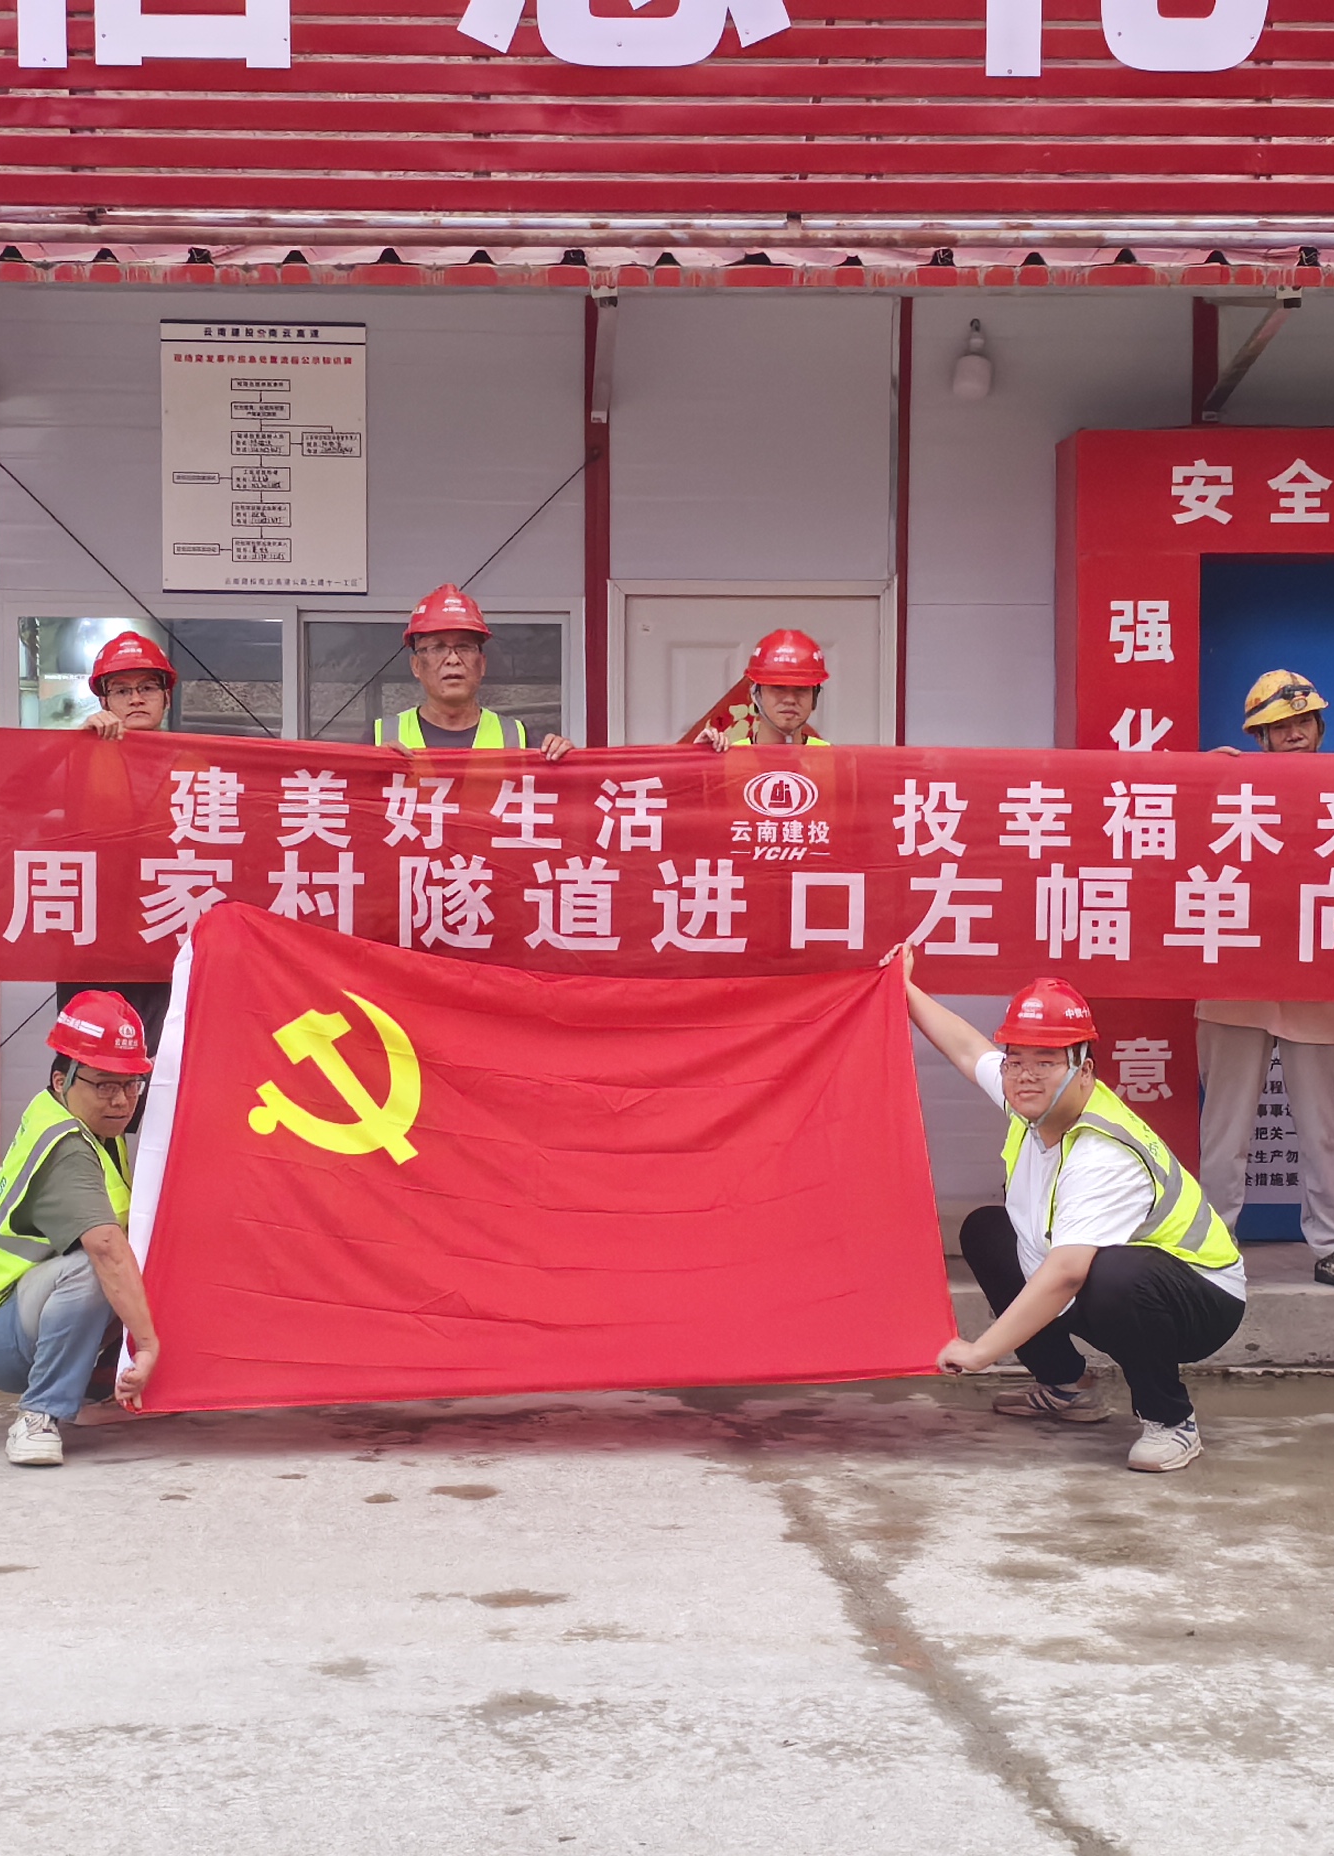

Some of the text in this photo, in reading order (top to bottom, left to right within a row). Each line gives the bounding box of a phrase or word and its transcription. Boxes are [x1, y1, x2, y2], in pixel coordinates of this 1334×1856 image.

[170, 765, 666, 851] 建美好生活
[730, 820, 830, 844] 云南建投
[752, 846, 808, 861] YCIH
[1111, 1037, 1173, 1102] 意
[1250, 1126, 1297, 1141] 把关一
